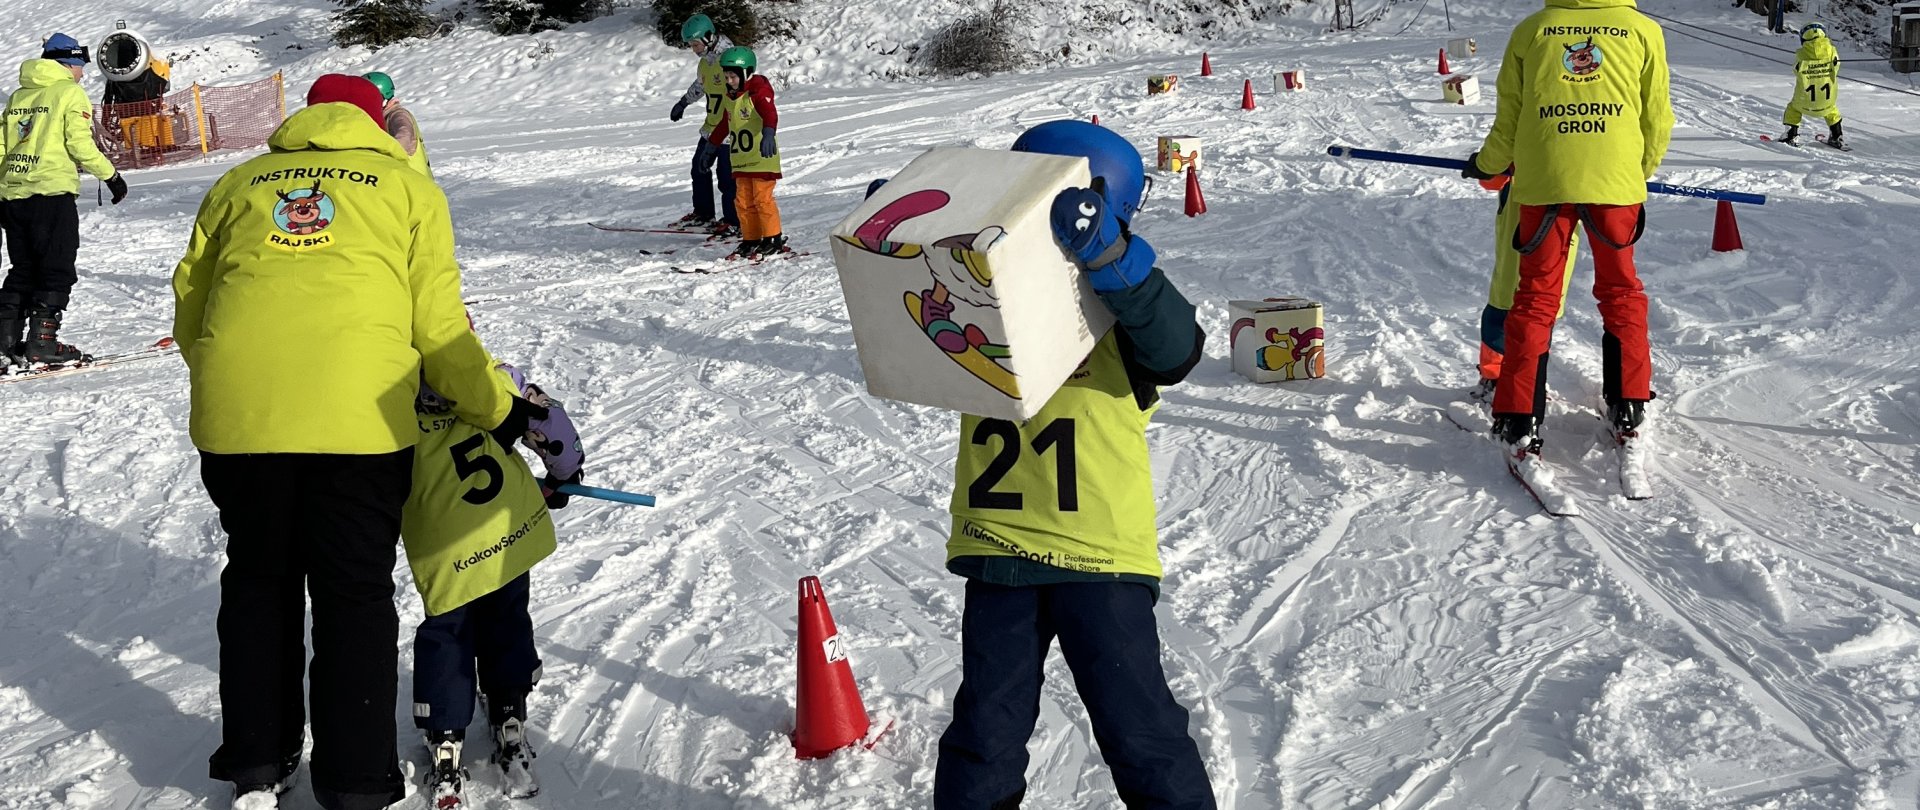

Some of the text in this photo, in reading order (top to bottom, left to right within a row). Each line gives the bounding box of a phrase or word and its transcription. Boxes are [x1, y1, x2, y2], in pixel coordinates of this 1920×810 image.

[1543, 26, 1629, 39] INSTRUKTOR
[1561, 74, 1601, 83] RAJ SKI
[1805, 83, 1831, 102] 11
[1539, 102, 1624, 119] MOSORNY
[1557, 116, 1606, 134] GROŃ
[730, 128, 754, 154] 20
[250, 167, 379, 187] INSTRUKTOR
[270, 234, 330, 247] RAJ SKI
[449, 432, 504, 505] 5
[968, 416, 1079, 512] 21
[453, 522, 530, 573] KrakowSport
[1064, 553, 1115, 565] Professional
[1064, 562, 1101, 572] Ski Store
[828, 637, 846, 662] 20
